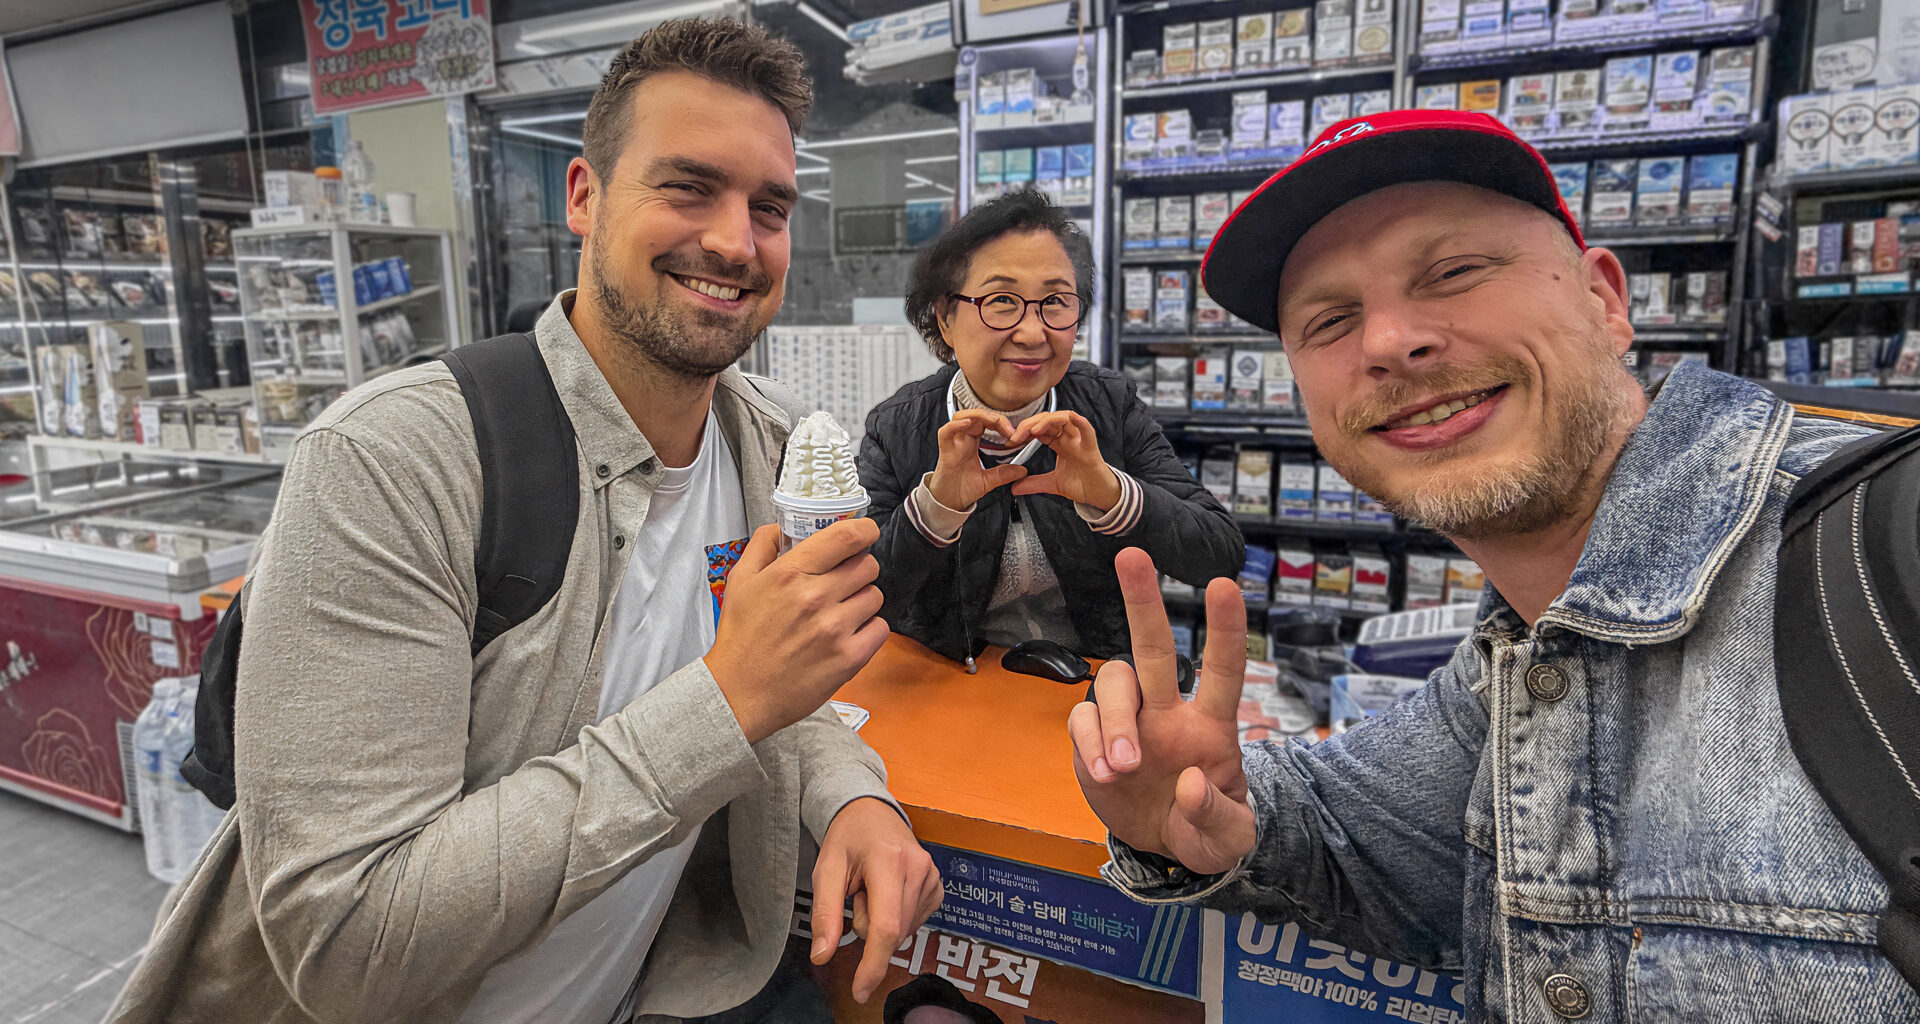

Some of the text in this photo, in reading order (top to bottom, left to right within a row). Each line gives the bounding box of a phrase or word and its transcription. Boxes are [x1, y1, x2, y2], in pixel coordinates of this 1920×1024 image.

[941, 877, 1140, 944] 소년에게 술·담배 판매금지
[952, 906, 967, 917] 12월
[968, 910, 984, 922] 31일
[935, 934, 1040, 1009] 반전
